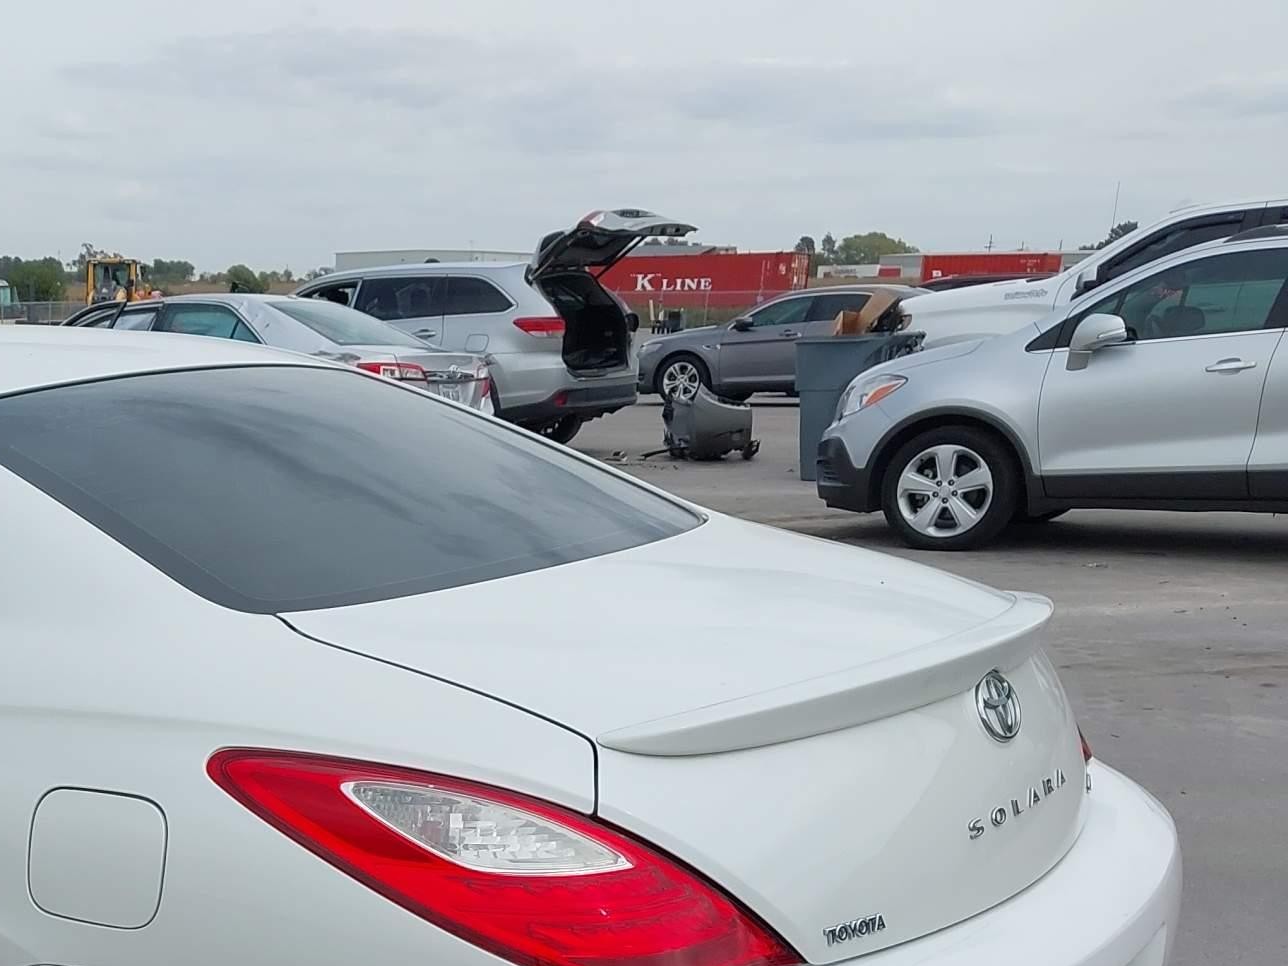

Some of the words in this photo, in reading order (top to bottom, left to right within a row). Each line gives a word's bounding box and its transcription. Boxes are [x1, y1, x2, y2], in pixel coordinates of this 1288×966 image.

[661, 277, 712, 291] LINE
[968, 768, 1066, 840] SOLARA
[822, 912, 887, 946] TOYOTA
